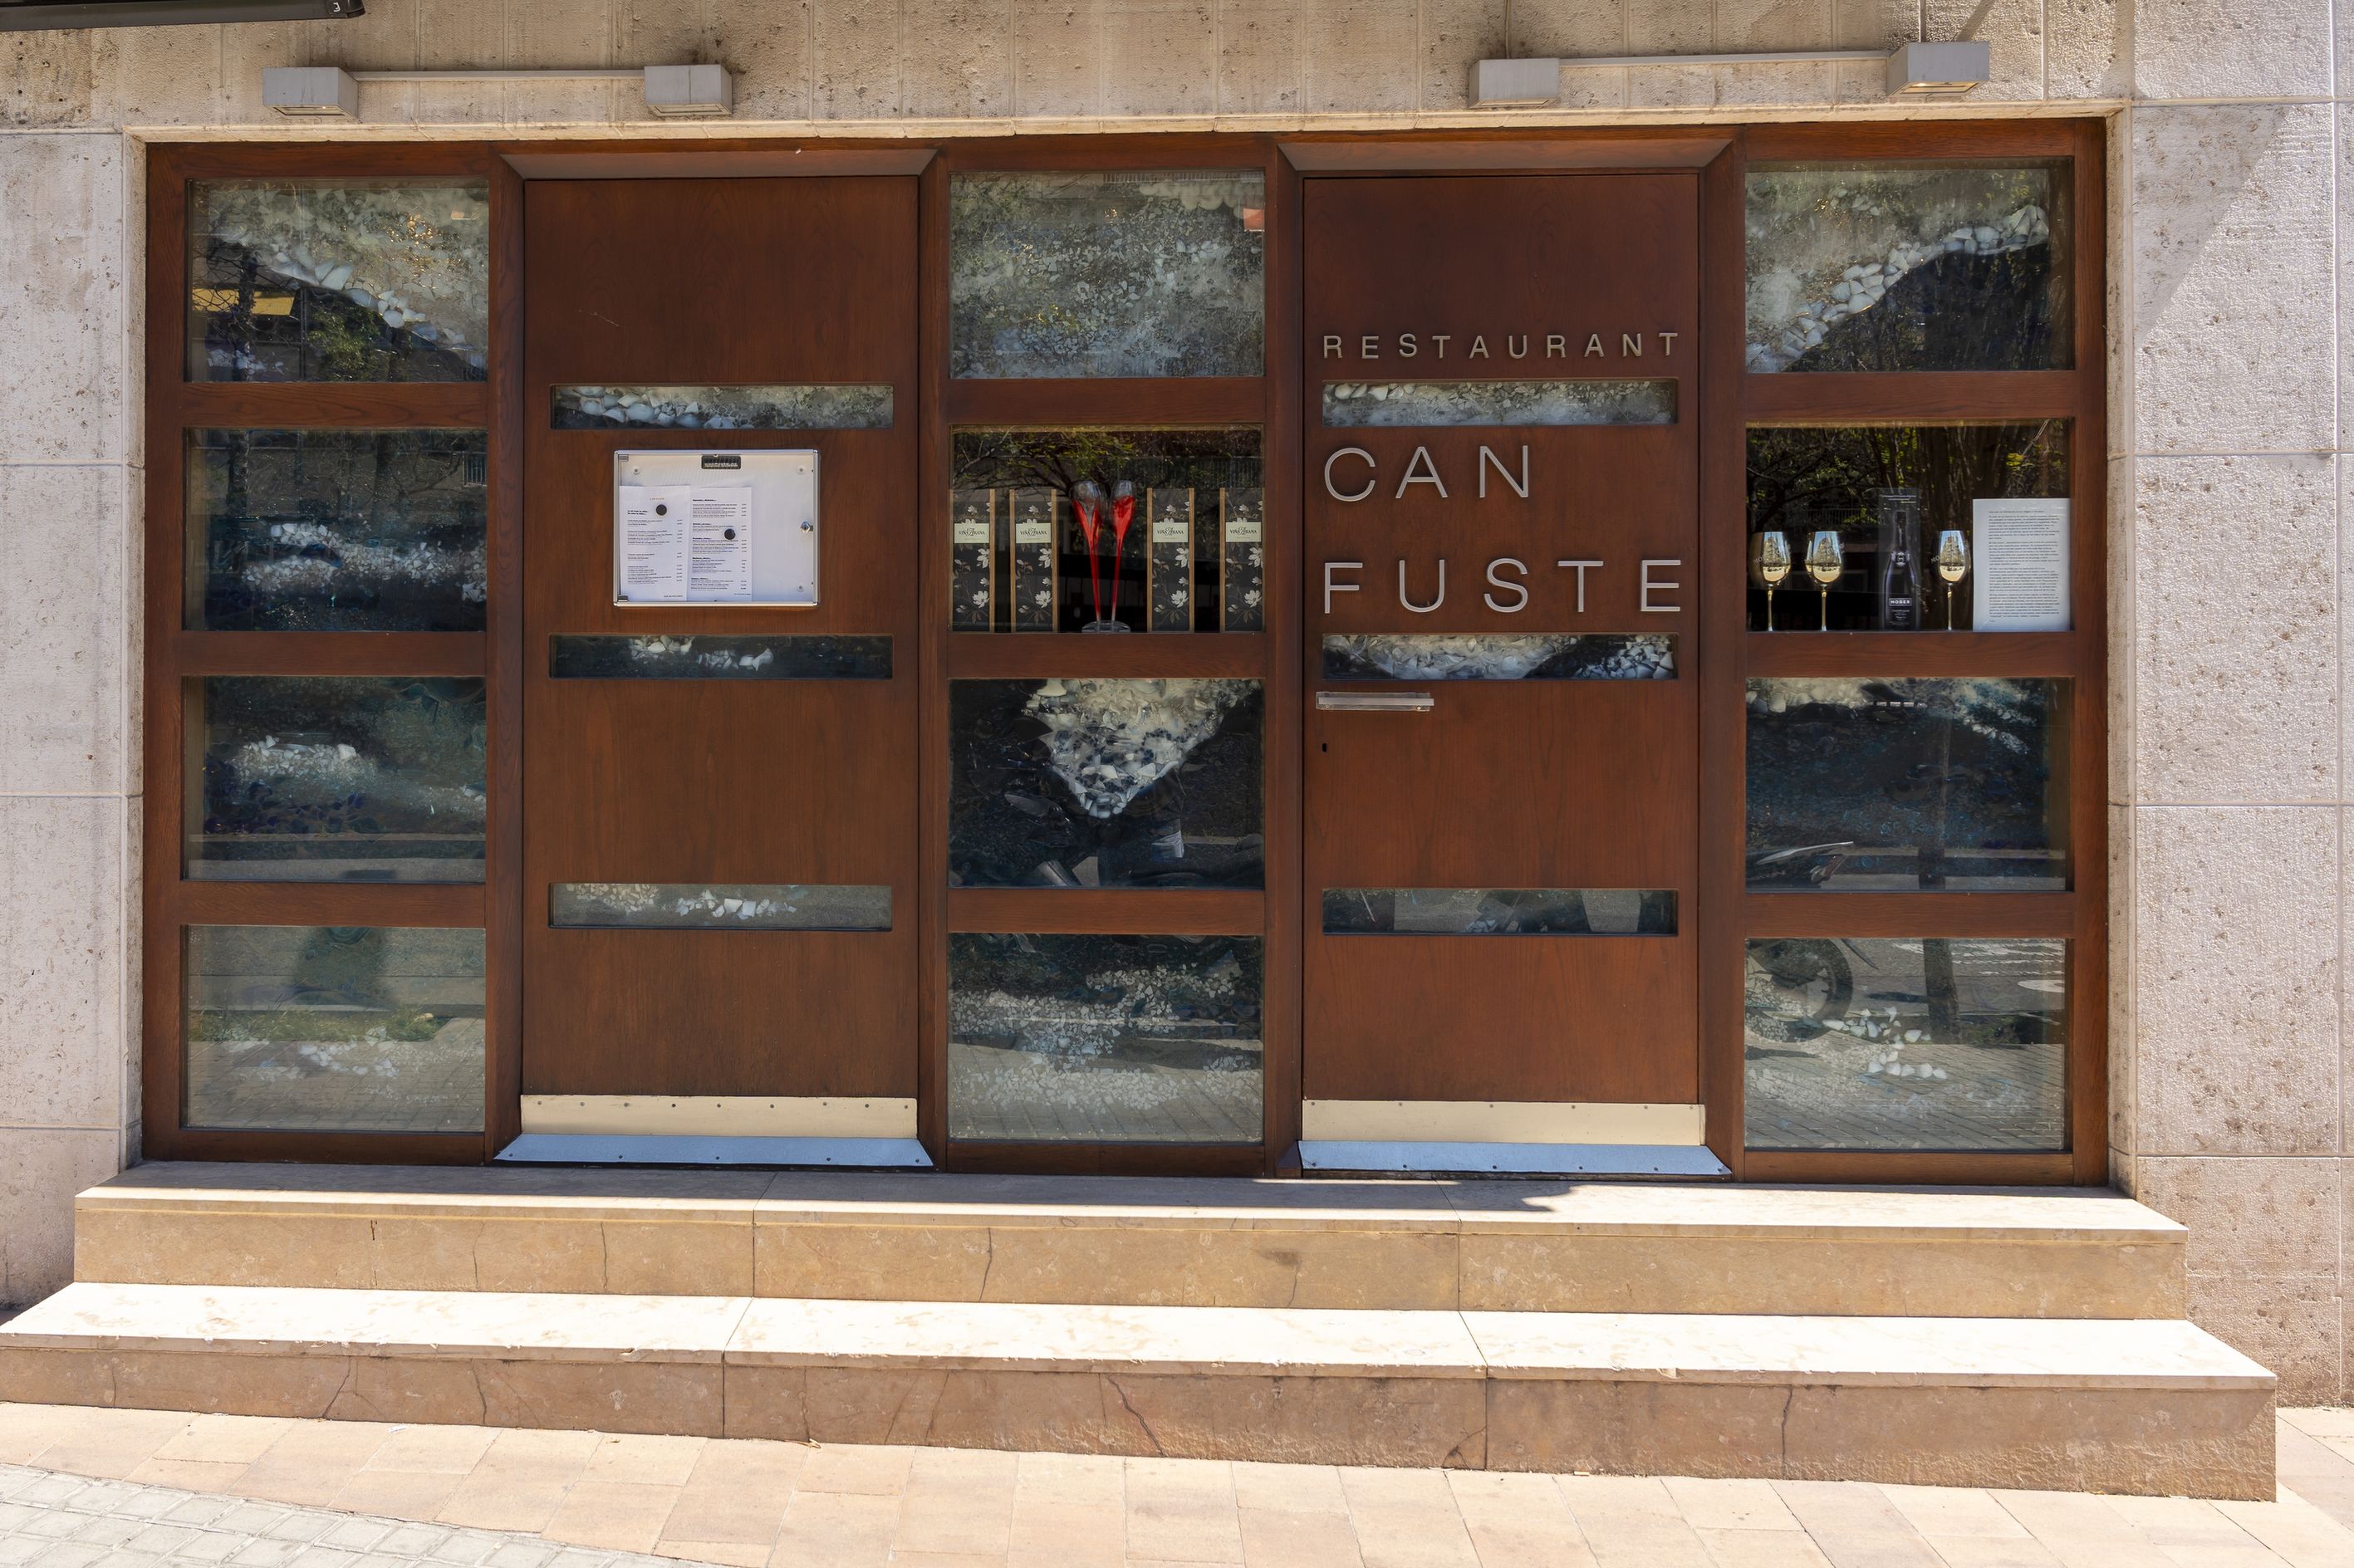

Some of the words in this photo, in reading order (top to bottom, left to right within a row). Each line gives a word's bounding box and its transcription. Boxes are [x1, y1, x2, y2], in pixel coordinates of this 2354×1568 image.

[1323, 332, 1679, 359] RESTAURANT
[1323, 445, 1529, 502] CAN
[1323, 558, 1681, 614] FUSTE
